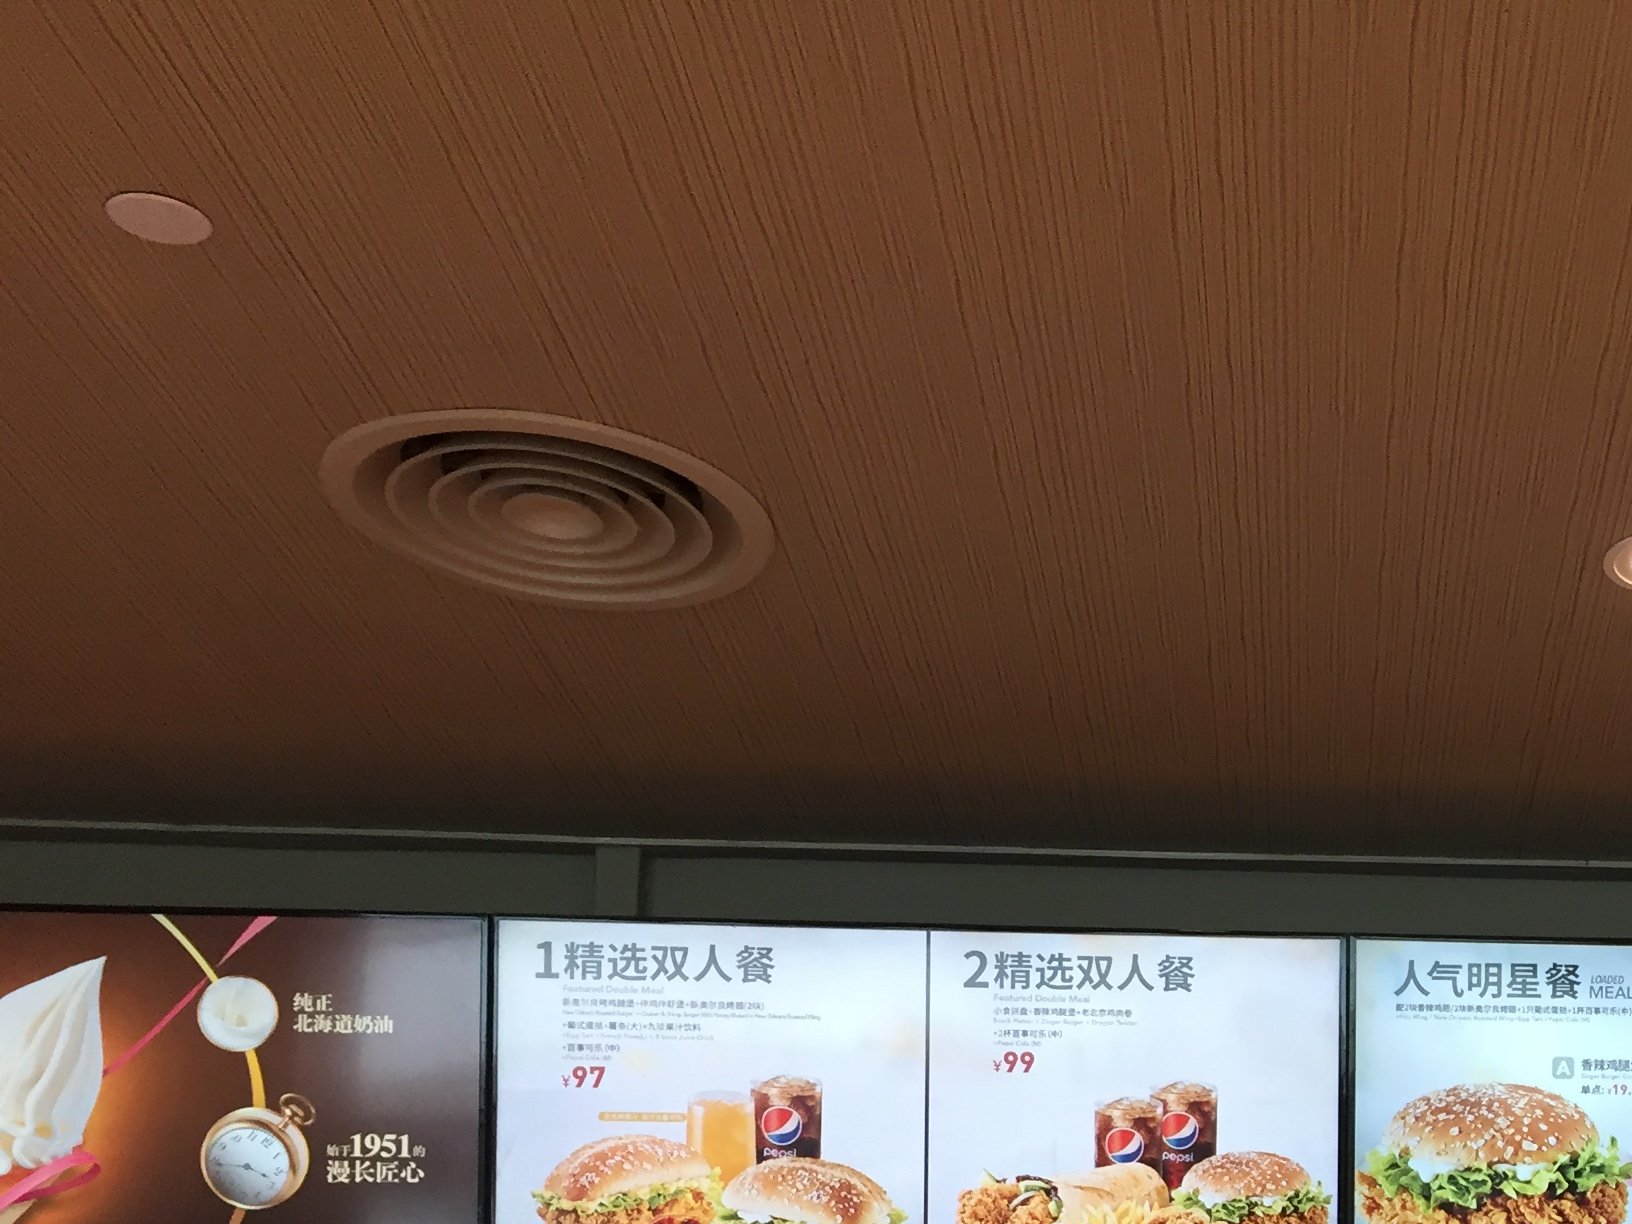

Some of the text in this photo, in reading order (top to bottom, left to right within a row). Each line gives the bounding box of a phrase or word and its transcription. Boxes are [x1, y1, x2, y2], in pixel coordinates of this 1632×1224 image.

[1393, 959, 1582, 1000] 人气明星餐
[1590, 975, 1625, 985] LOADED
[292, 992, 334, 1012] 纯正
[292, 1013, 394, 1035] 北海道奶油
[992, 1051, 1035, 1073] ¥99
[1556, 1060, 1571, 1076] A
[561, 1066, 606, 1088] ¥97
[326, 1132, 427, 1159] 始于1951的
[1161, 1151, 1194, 1164] pepsi
[326, 1159, 426, 1184] 漫长匠心
